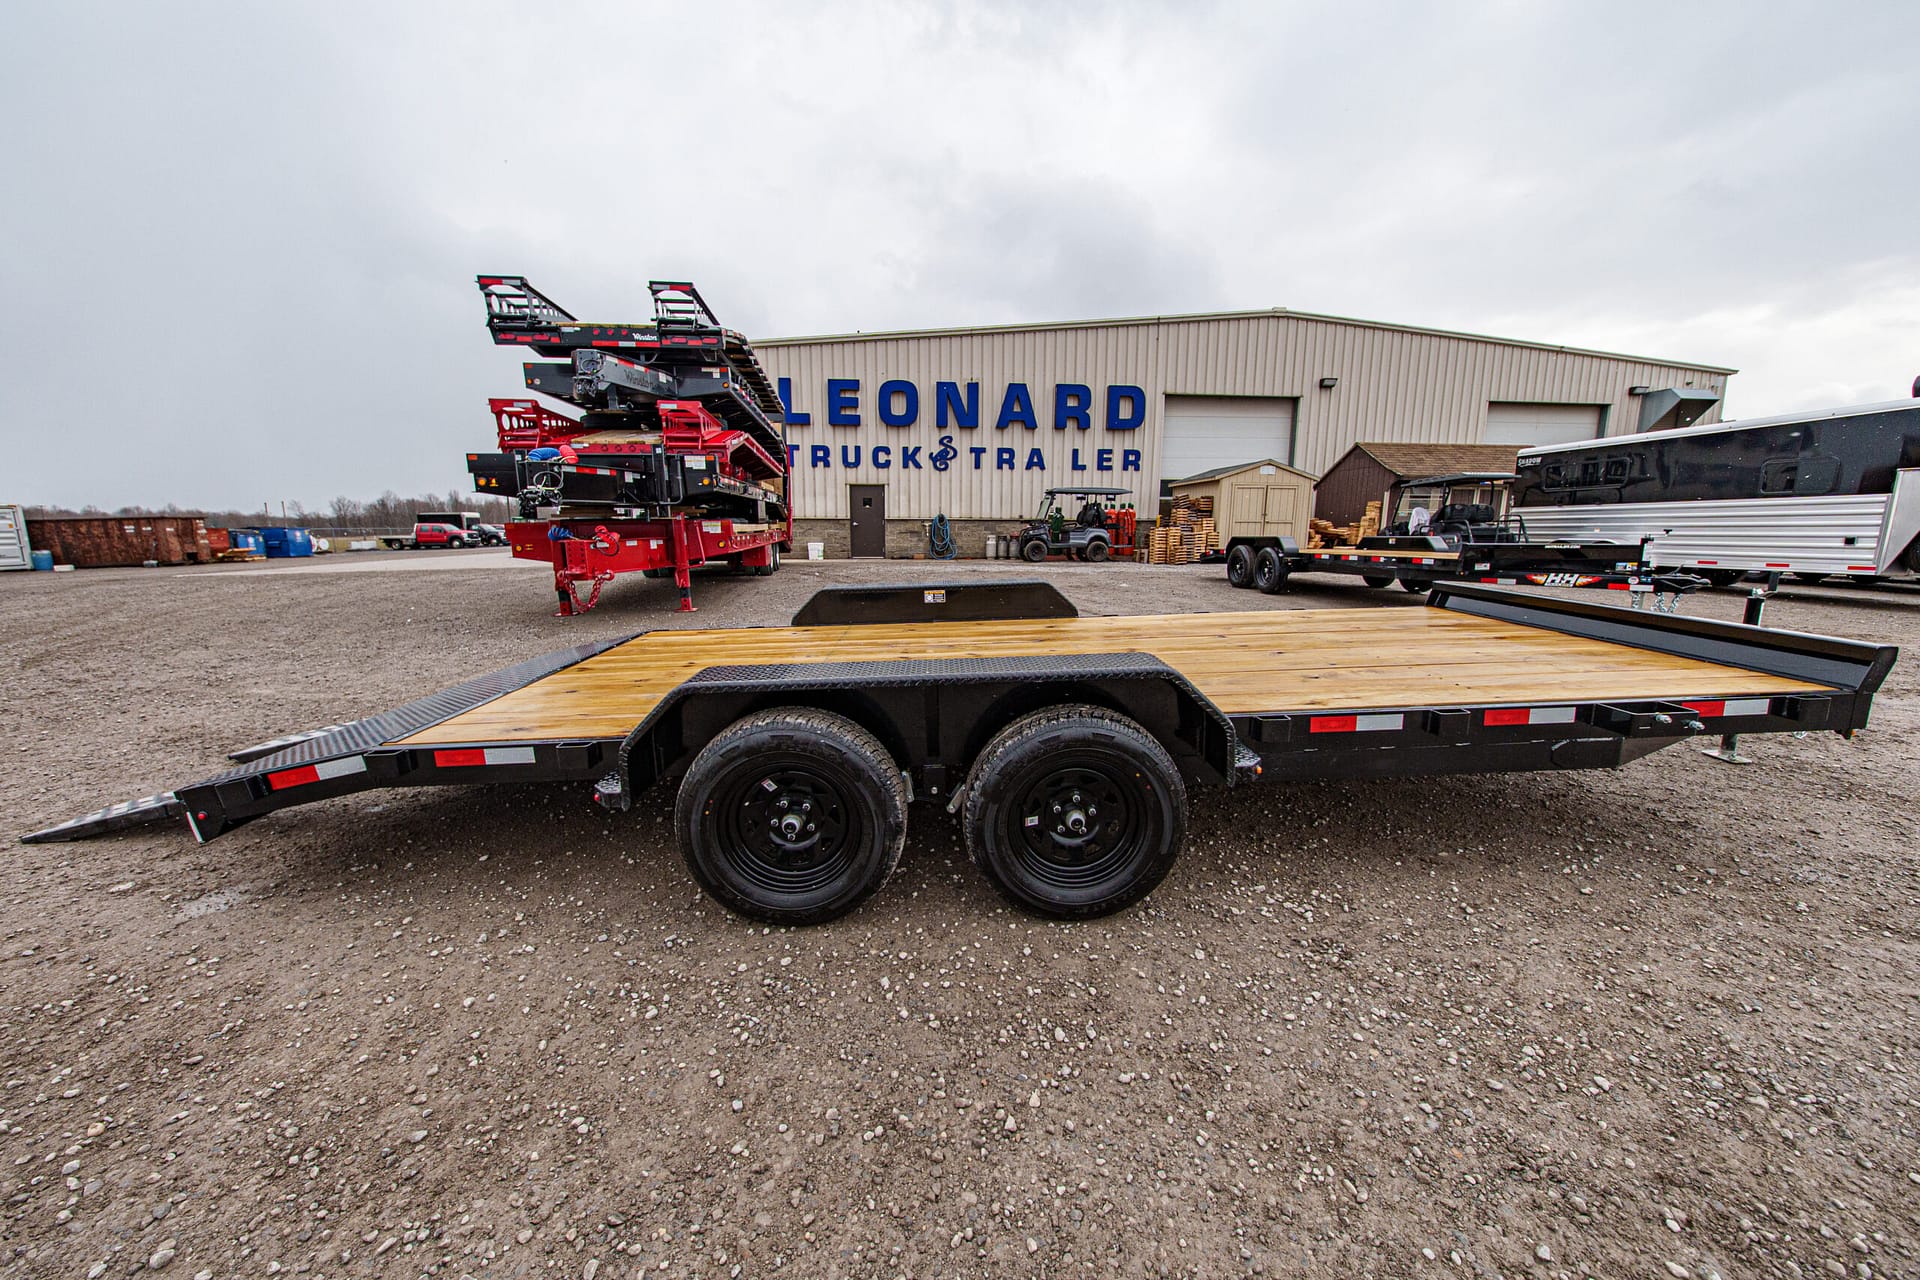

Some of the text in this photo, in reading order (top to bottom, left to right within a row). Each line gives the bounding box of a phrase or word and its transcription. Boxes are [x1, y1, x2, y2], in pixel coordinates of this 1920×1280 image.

[778, 377, 1146, 430] LEONARD
[787, 444, 923, 470] TRUCK
[969, 446, 1142, 471] TRALER
